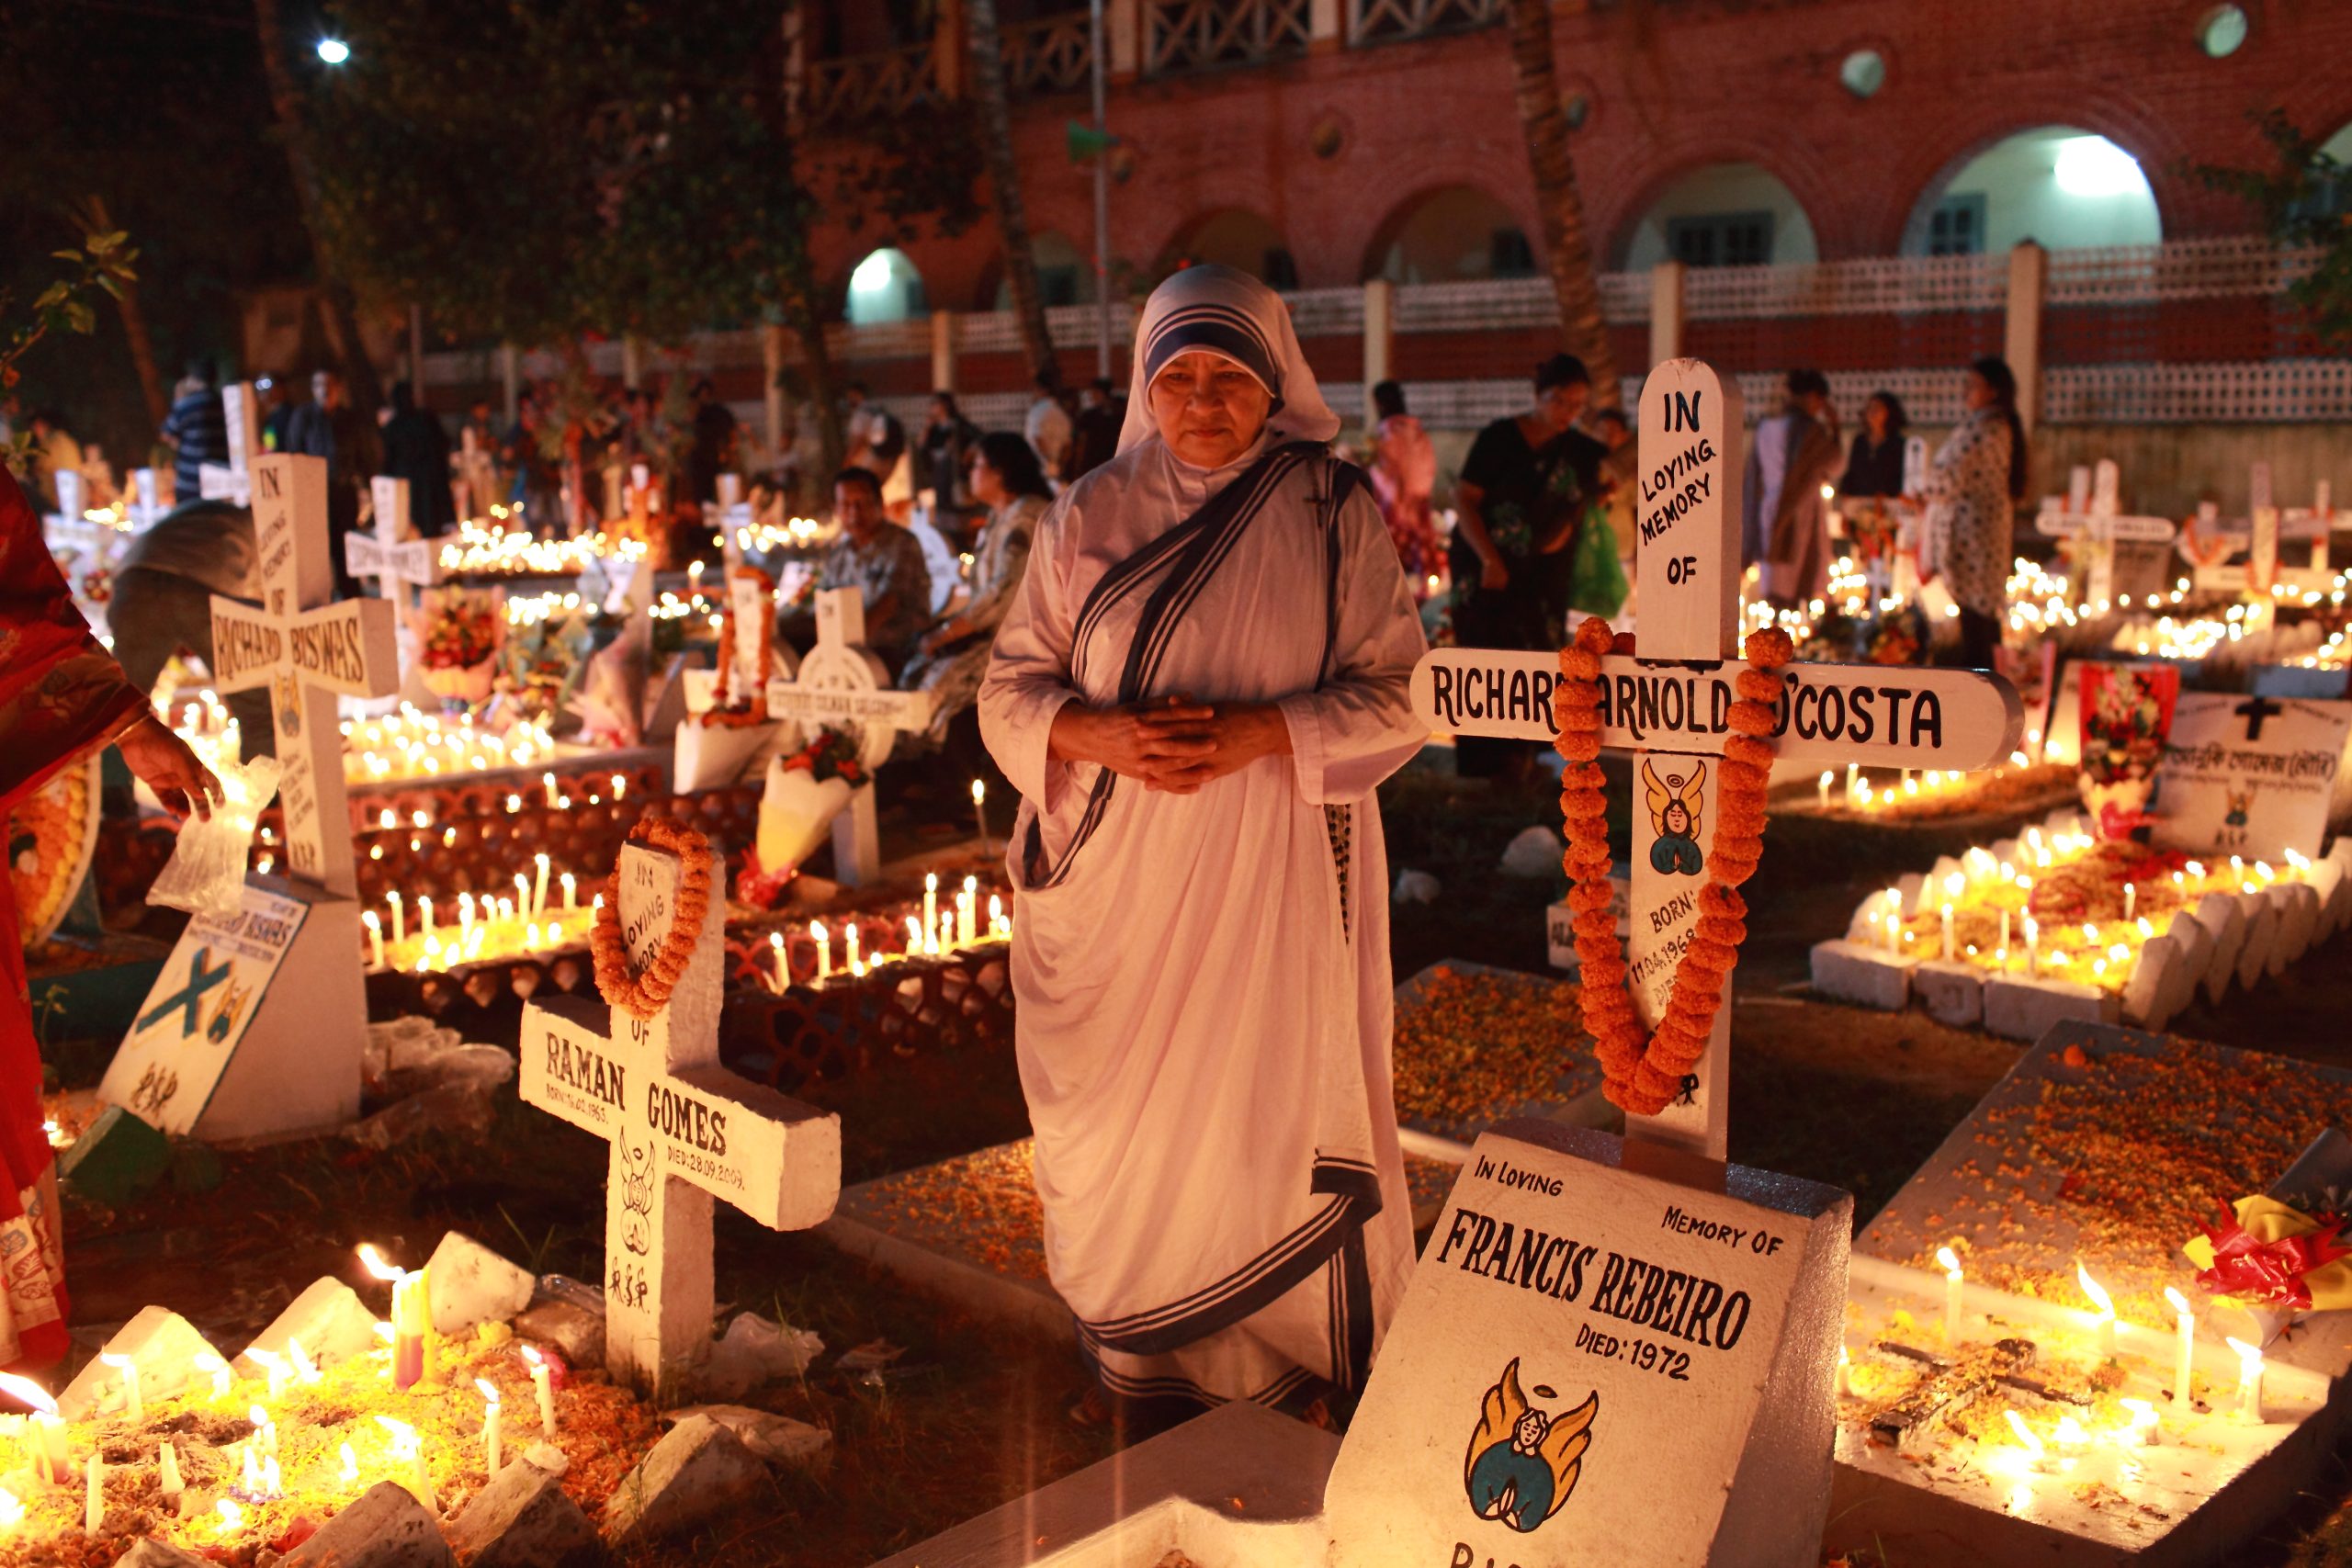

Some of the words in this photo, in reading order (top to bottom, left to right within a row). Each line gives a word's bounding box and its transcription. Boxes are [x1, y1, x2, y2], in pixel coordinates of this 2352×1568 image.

[1664, 390, 1701, 433] IN
[259, 468, 280, 497] IN
[1640, 472, 1711, 547] MEMORY
[1667, 556, 1697, 585] OF
[215, 615, 281, 682] RICHARD
[291, 616, 364, 683] BISWAS
[1430, 664, 1562, 736] RICHAR
[635, 865, 654, 888] IN
[1650, 890, 1697, 934] BORN:
[546, 1032, 626, 1111] RAMAN
[648, 1082, 727, 1157] GOMES
[1475, 1155, 1495, 1180] IN
[1497, 1161, 1564, 1197] LOVING
[1661, 1205, 1747, 1249] MEMORY
[1751, 1230, 1784, 1257] OF
[1437, 1208, 1599, 1303] FRANCIS
[1589, 1251, 1751, 1351] REBEIRO
